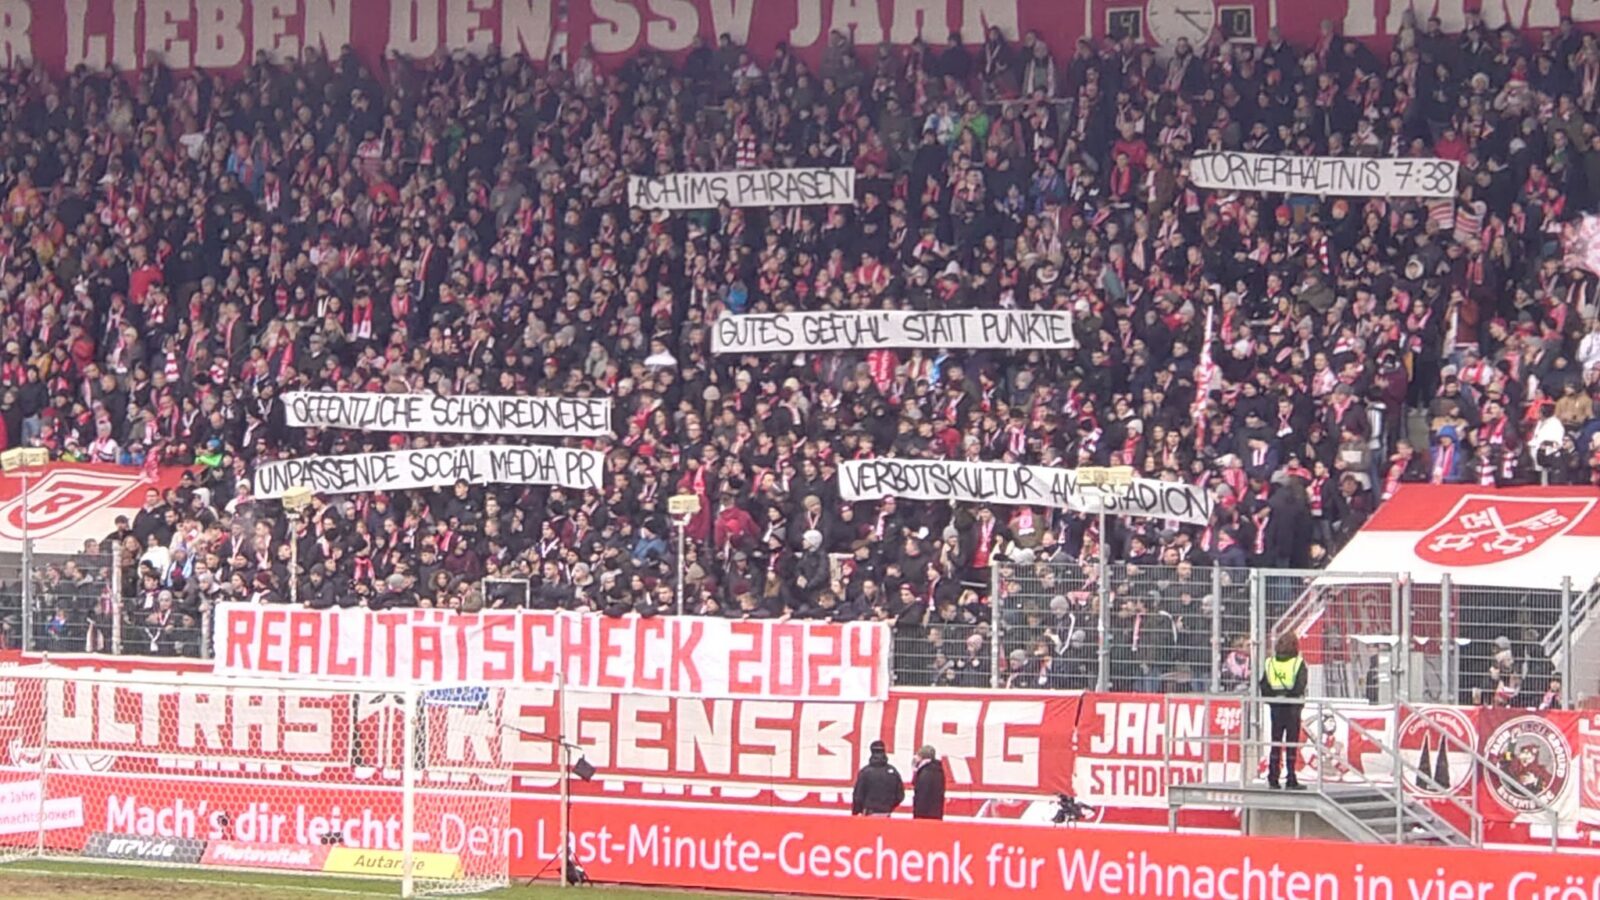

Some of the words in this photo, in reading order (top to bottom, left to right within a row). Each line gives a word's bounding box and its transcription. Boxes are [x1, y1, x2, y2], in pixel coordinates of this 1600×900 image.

[66, 0, 350, 72] LIEBEN
[386, 0, 550, 60] DEN
[590, 0, 753, 53] SSV
[790, 0, 1020, 47] JAHN
[737, 170, 850, 203] PHRASEN
[1193, 152, 1381, 191] TORVERHÄLTNIS
[1394, 160, 1455, 193] 7:38
[719, 315, 793, 346] GUTES
[903, 313, 973, 344] STATT
[982, 312, 1071, 344] PUNKTE
[258, 455, 399, 494] UNPASSENDE
[566, 451, 597, 489] PR
[845, 462, 1041, 500] VERBOTSKULTUR
[226, 609, 704, 693] REALITÄTSCHECK
[728, 621, 881, 697] 2024
[48, 679, 332, 754] ULTRAS
[447, 688, 1046, 788] REGENSBURG
[1090, 702, 1206, 756] JAHN
[1089, 764, 1204, 797] STADION
[106, 795, 228, 840] Mach's
[235, 802, 287, 843] dir
[295, 805, 400, 851] leicht
[440, 813, 523, 858] Dein
[537, 818, 975, 888] Last-Minute-Geschenk
[987, 842, 1045, 890] für
[1057, 846, 1339, 900] Weihnachten
[1355, 863, 1394, 900] in
[1408, 867, 1494, 900] vier
[354, 854, 426, 871] Autarie
